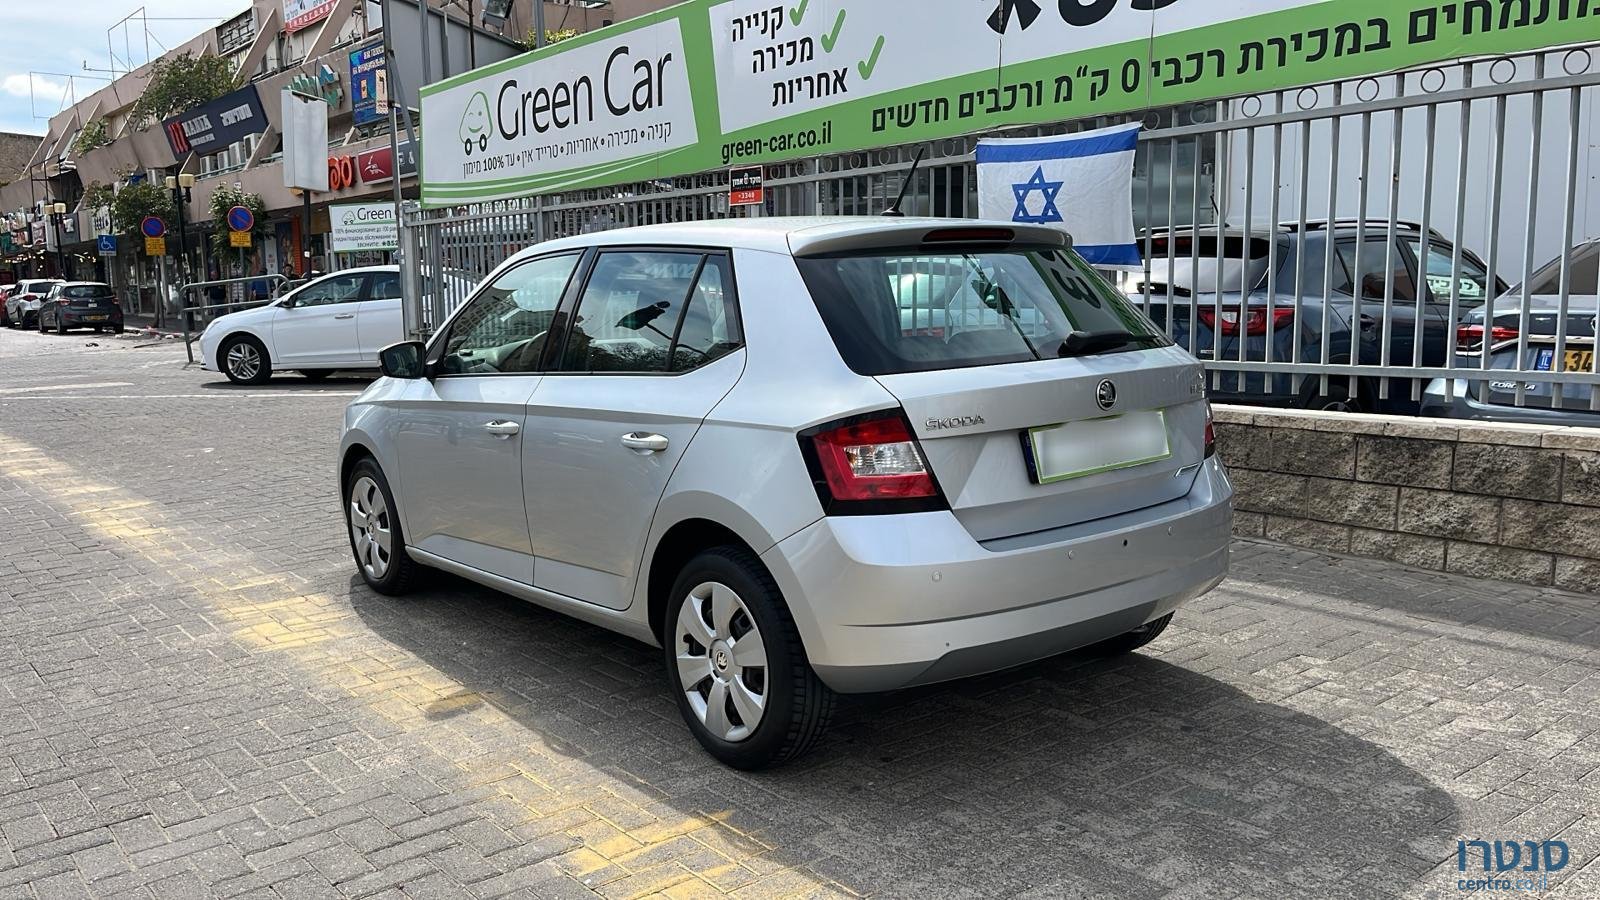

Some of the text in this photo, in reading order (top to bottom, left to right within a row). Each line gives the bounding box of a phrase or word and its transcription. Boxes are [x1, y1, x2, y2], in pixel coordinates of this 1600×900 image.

[732, 6, 784, 43] קנייה
[752, 36, 814, 74] מכירה
[1237, 17, 1391, 75] במכירת
[772, 67, 848, 107] אחריות
[1121, 58, 1141, 93] 0
[1151, 48, 1226, 88] רכבי
[497, 46, 672, 141] Green Car
[958, 80, 1043, 119] ורכבים
[872, 97, 949, 132] חדשים
[463, 122, 672, 179] קניה מכירה אחריות טרייד אין עד 100% מימון
[721, 120, 832, 164] green-car.co.il
[357, 207, 392, 221] Green
[1491, 381, 1536, 390] COROLA
